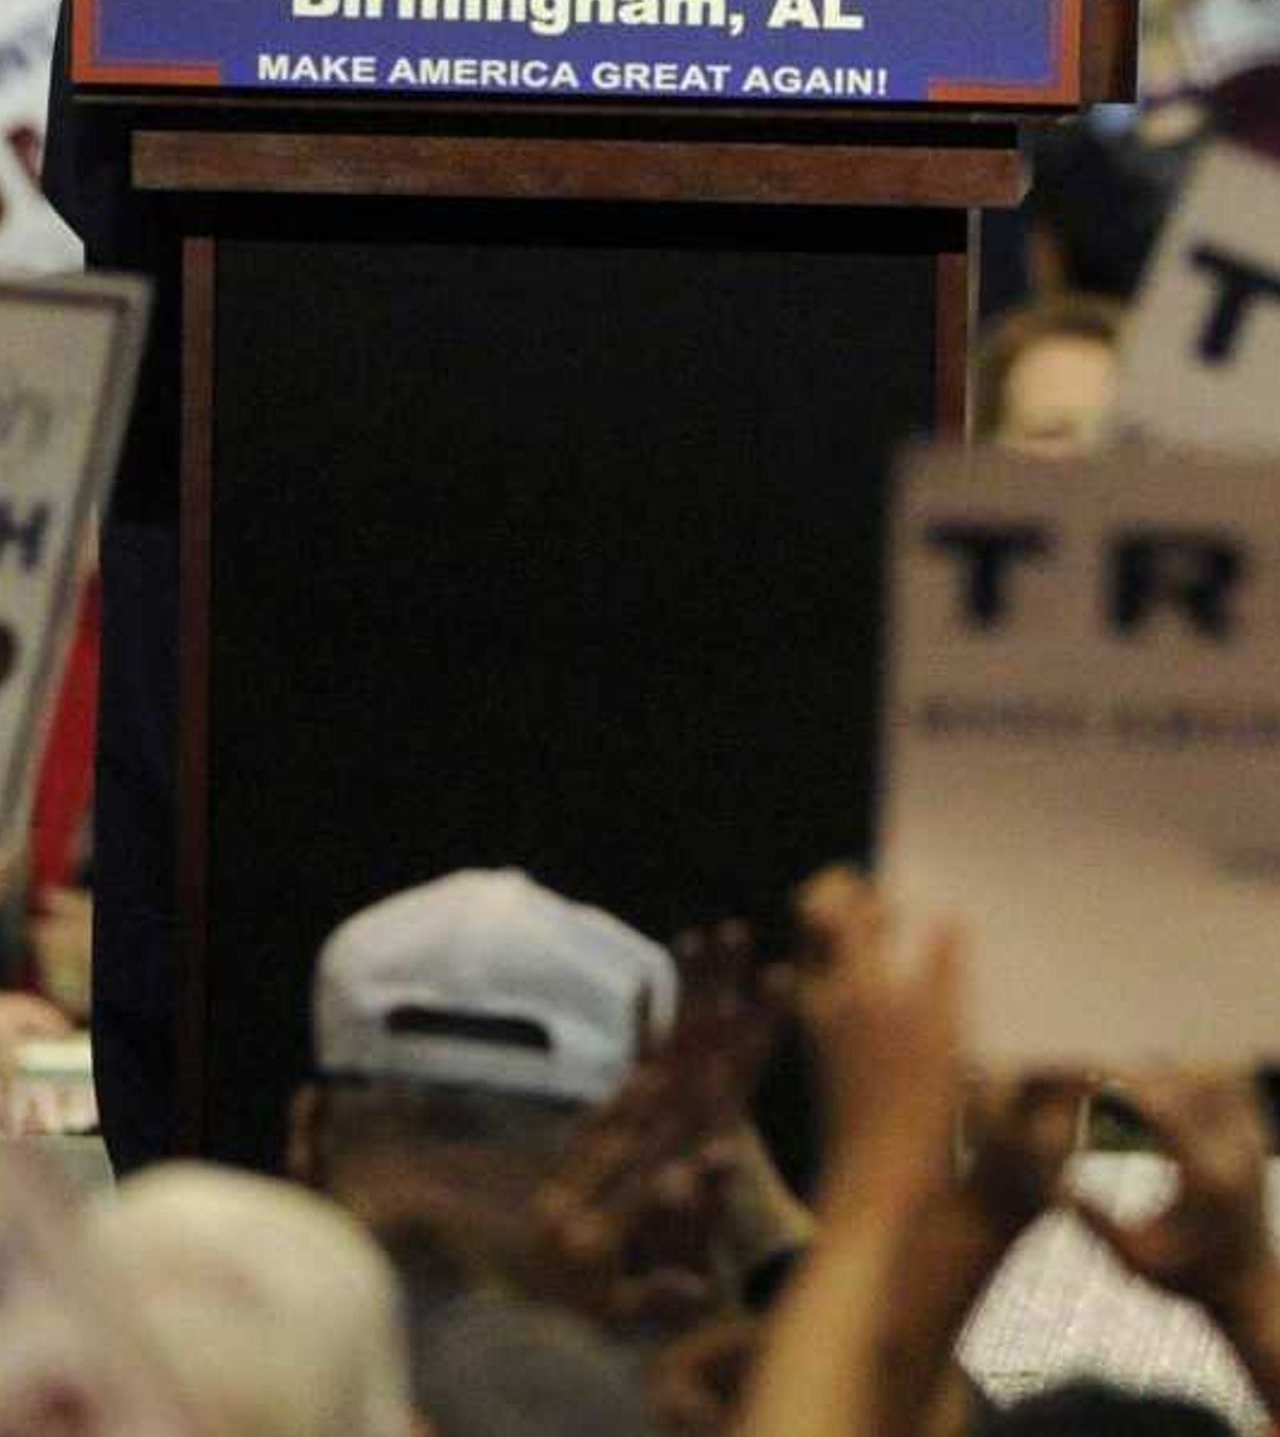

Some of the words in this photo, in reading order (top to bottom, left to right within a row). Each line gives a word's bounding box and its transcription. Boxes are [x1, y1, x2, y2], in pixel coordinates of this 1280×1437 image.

[256, 54, 378, 85] MAKE
[388, 58, 579, 91] AMERICA
[592, 62, 730, 94] GREAT
[741, 66, 889, 97] AGAIN!
